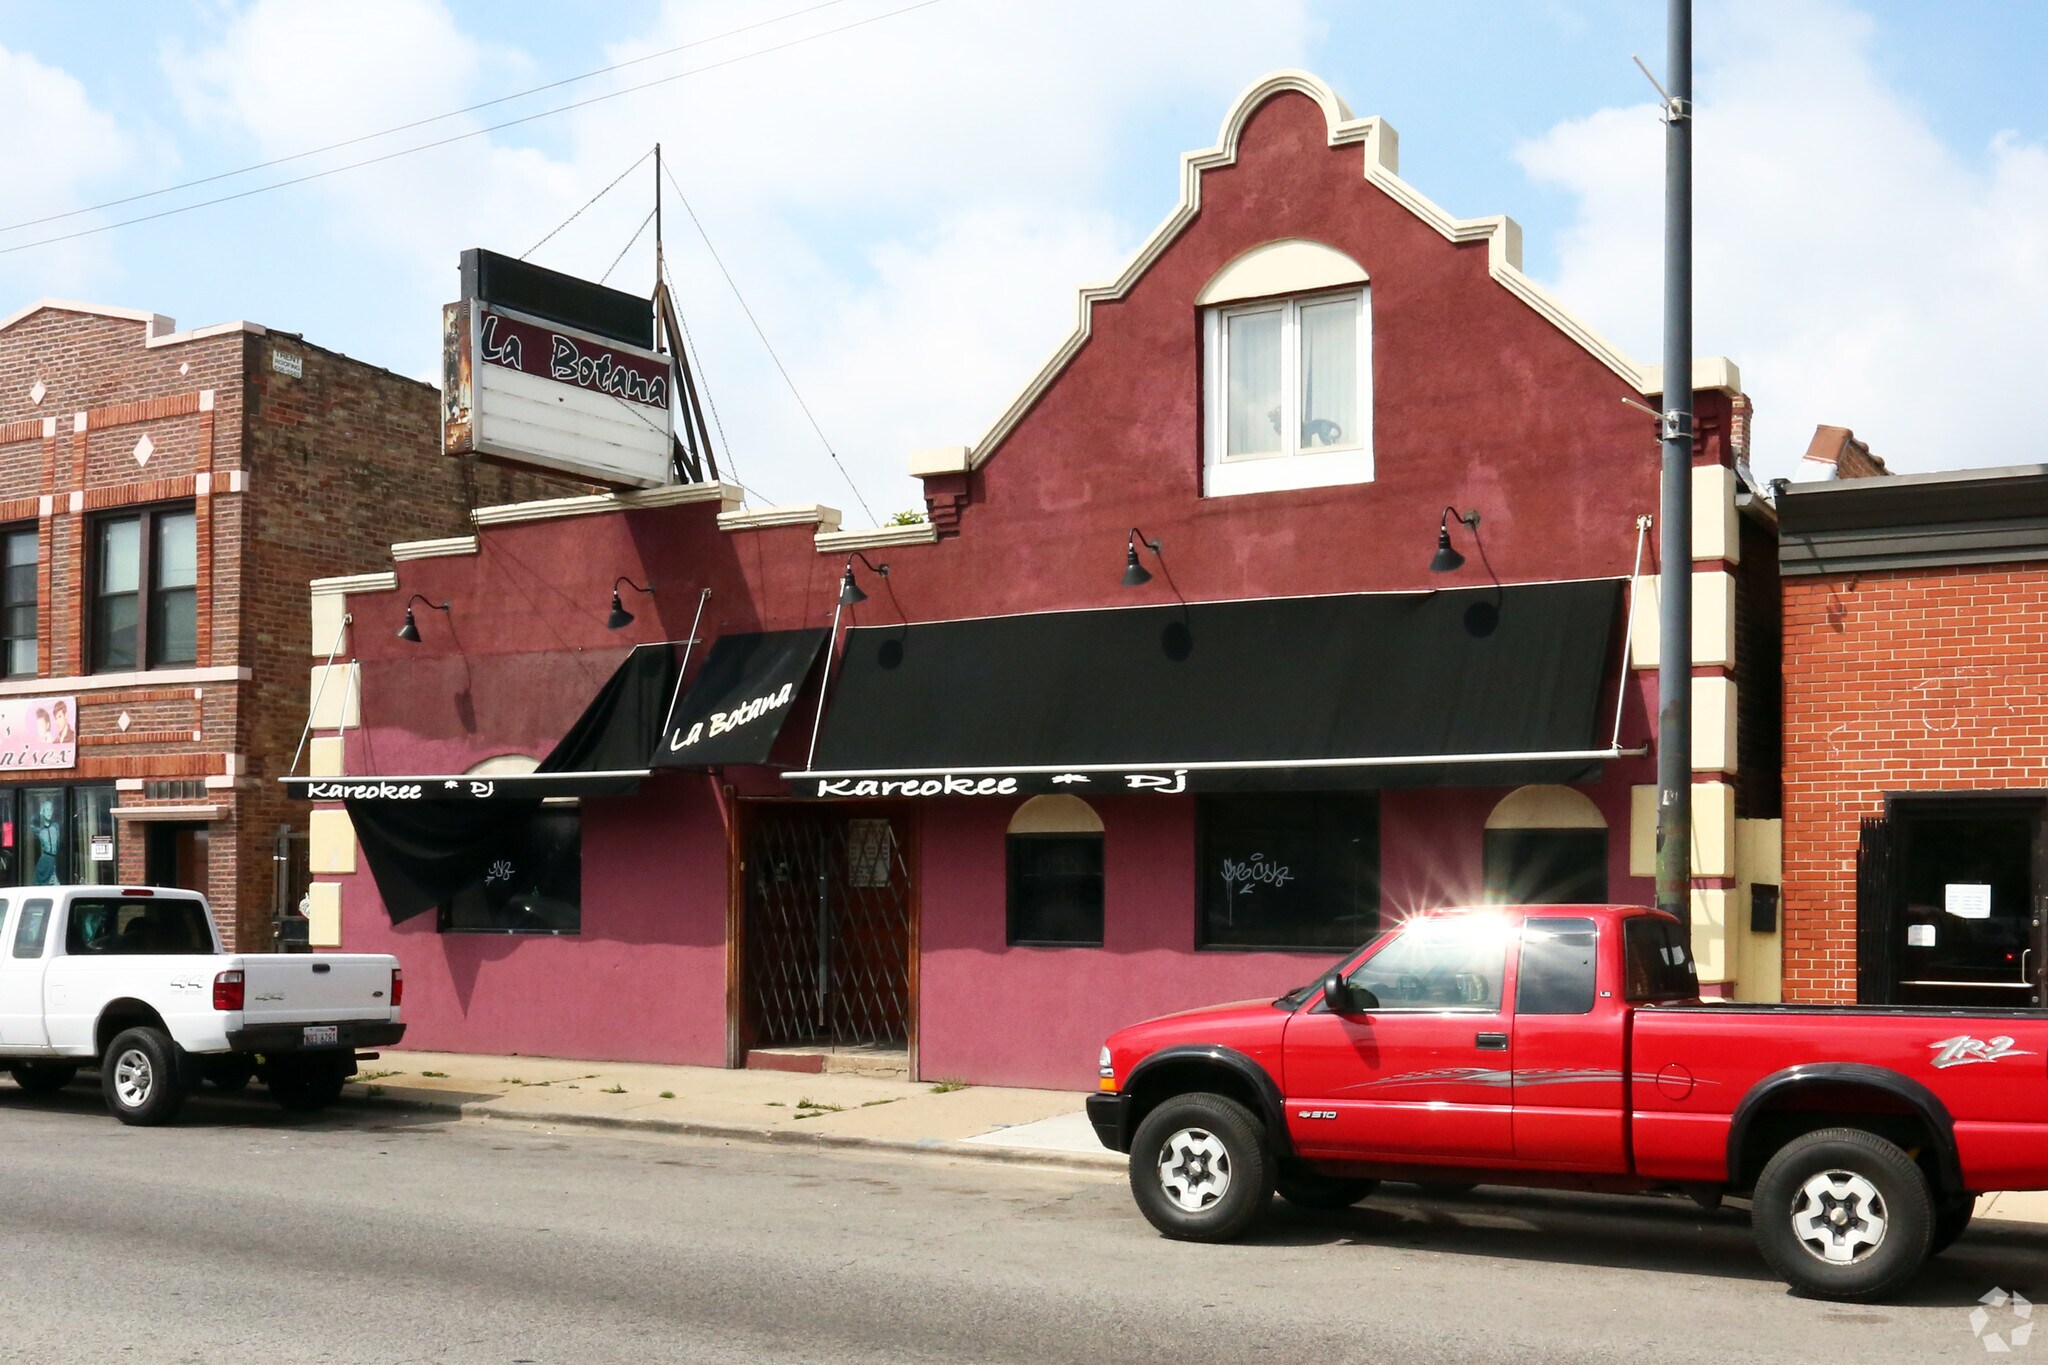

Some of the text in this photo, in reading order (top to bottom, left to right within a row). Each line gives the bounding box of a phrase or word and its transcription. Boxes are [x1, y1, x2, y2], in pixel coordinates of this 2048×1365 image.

[481, 315, 666, 408] La Botana
[670, 682, 793, 751] La Botana
[307, 782, 422, 799] Kareokee
[817, 773, 1018, 797] Kareokee
